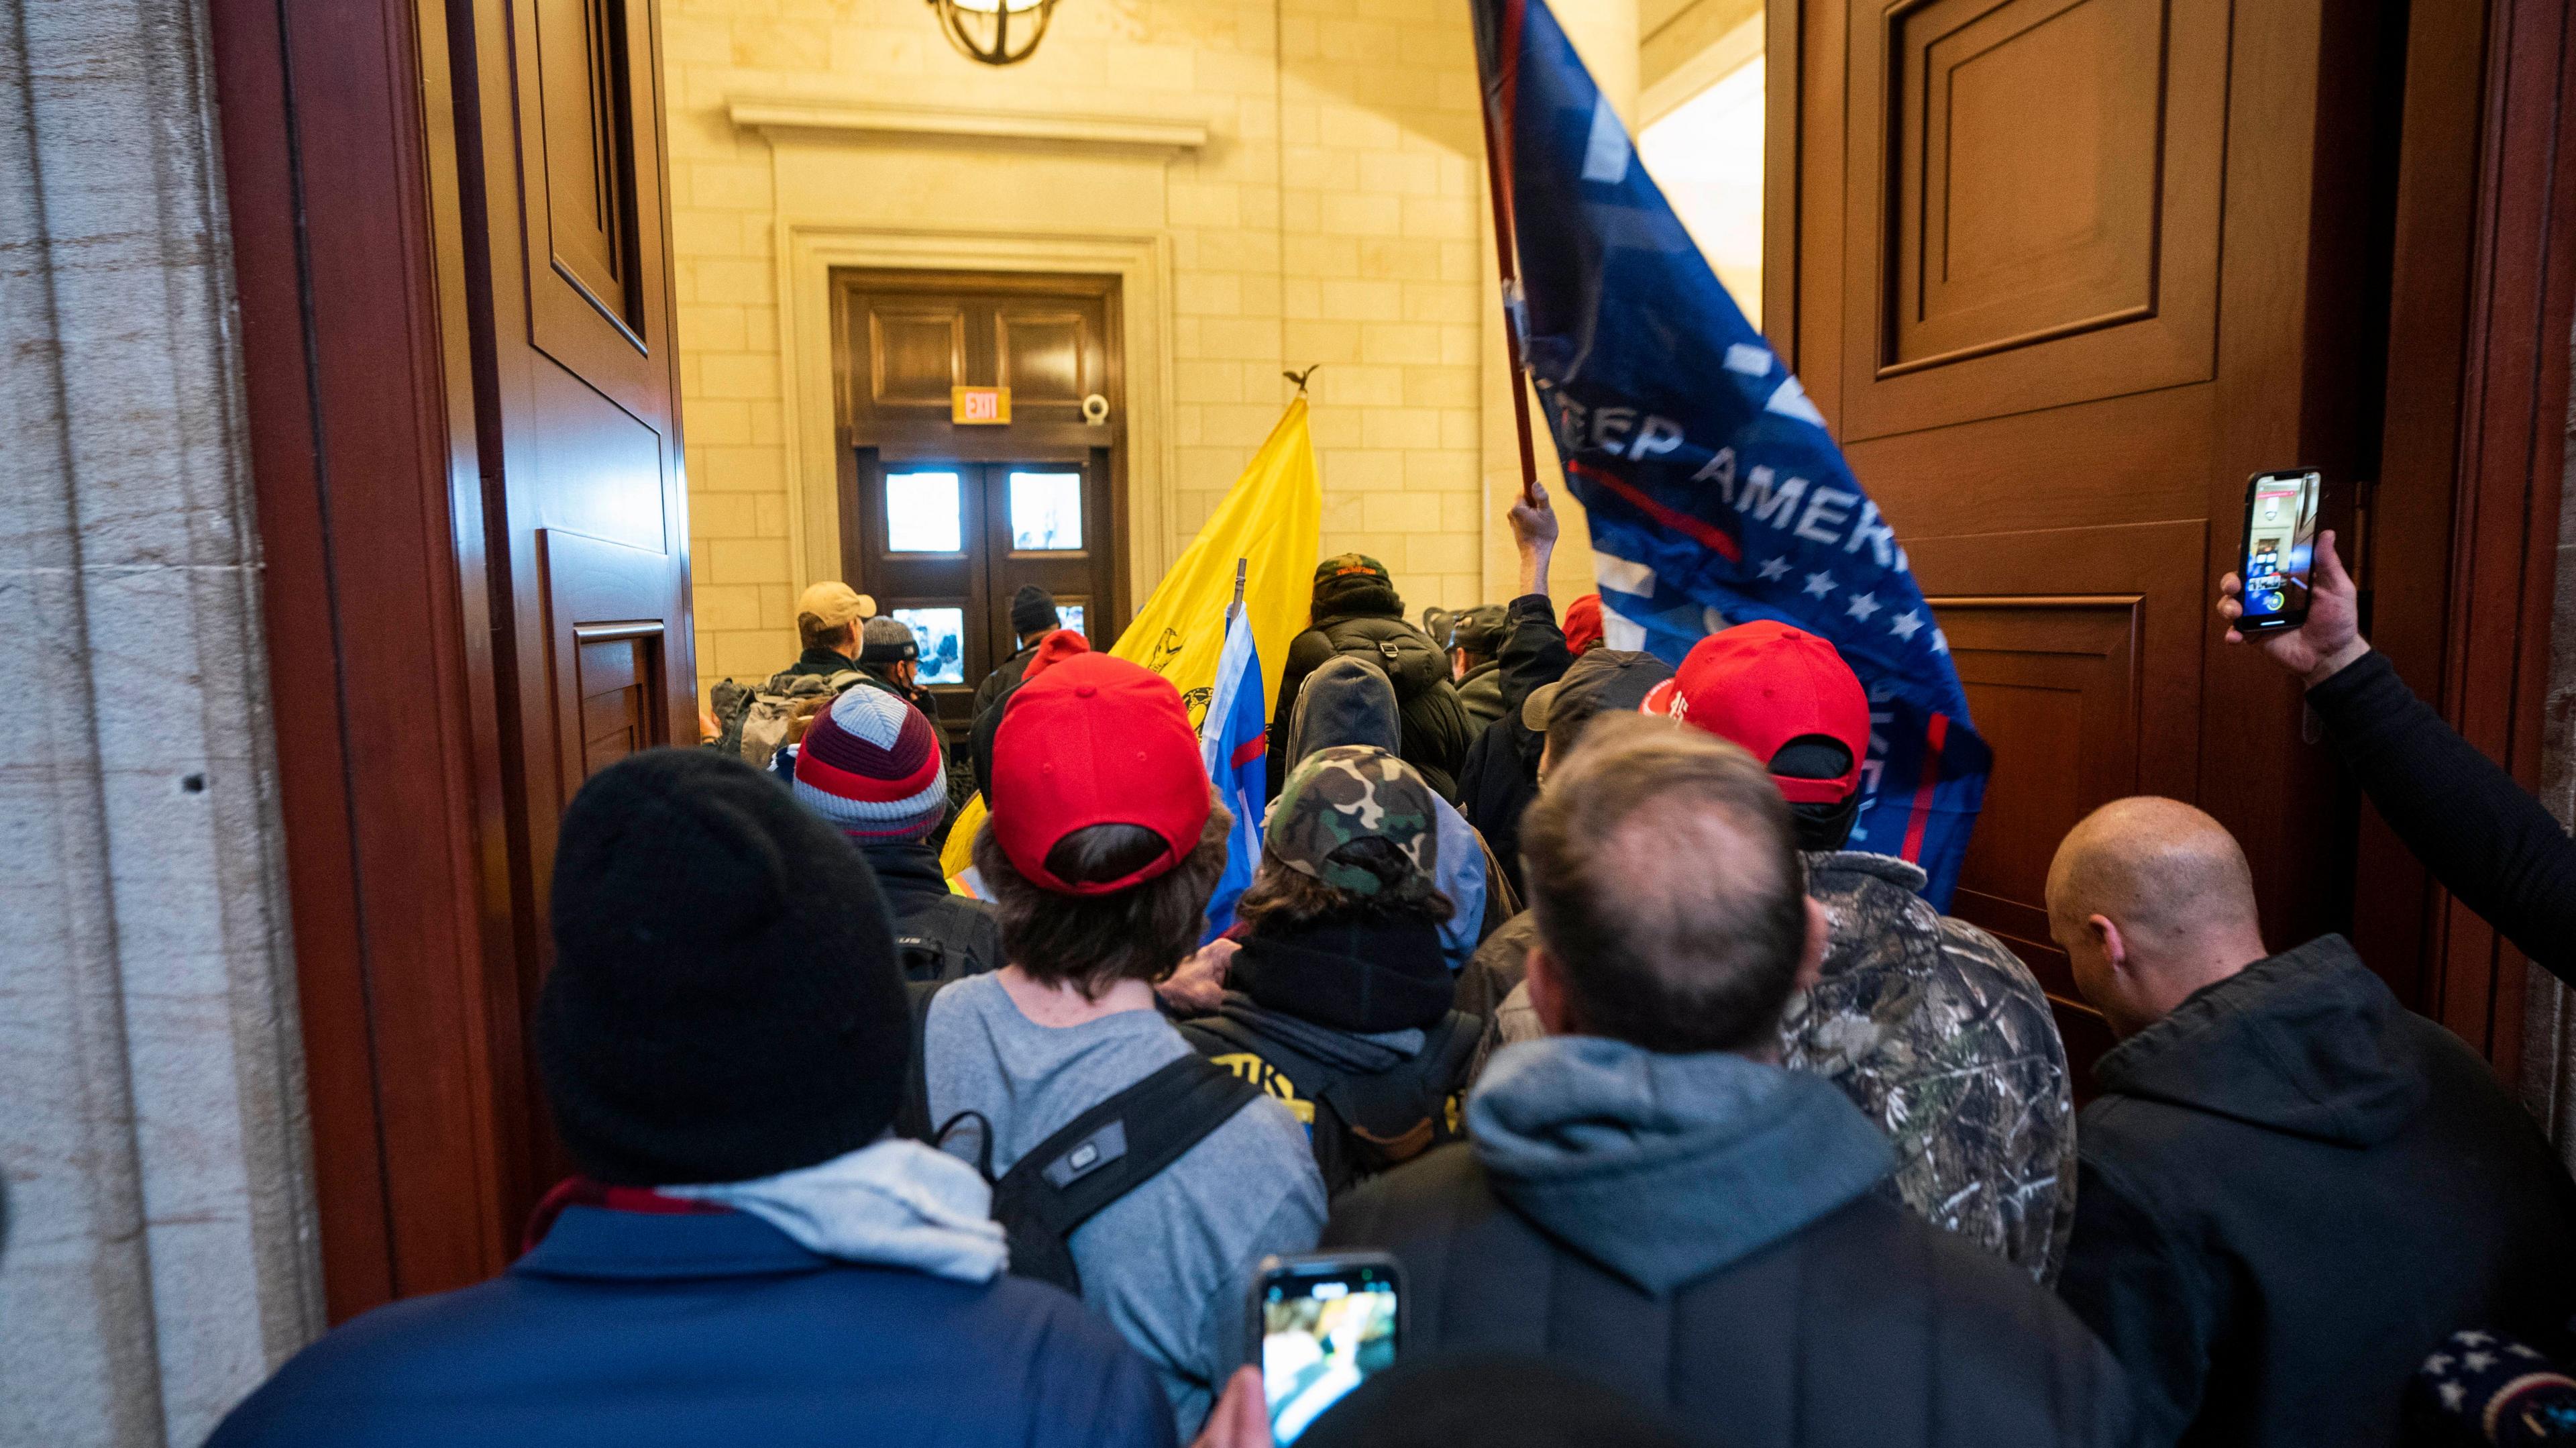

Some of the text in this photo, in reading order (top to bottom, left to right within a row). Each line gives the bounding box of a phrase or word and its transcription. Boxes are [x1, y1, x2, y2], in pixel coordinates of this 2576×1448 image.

[965, 393, 997, 419] EXIT
[1554, 391, 1909, 574] EEP AMER
